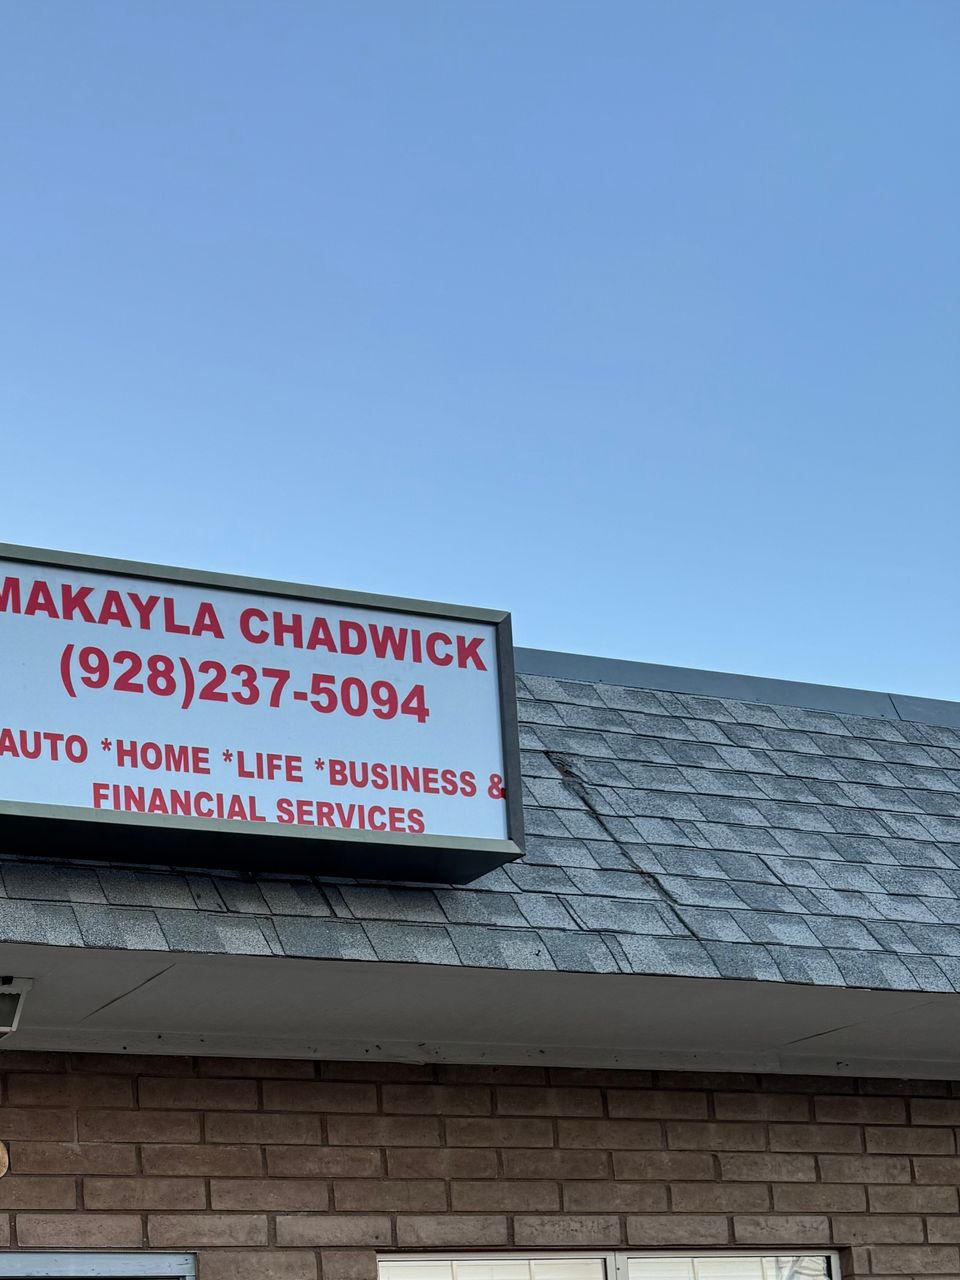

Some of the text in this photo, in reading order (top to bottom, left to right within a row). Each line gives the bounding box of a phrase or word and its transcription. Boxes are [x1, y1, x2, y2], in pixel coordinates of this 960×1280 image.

[240, 607, 488, 671] CHADWICK
[59, 643, 430, 723] (928)237-5094
[92, 782, 425, 834] FINANCIAL SERVICES
